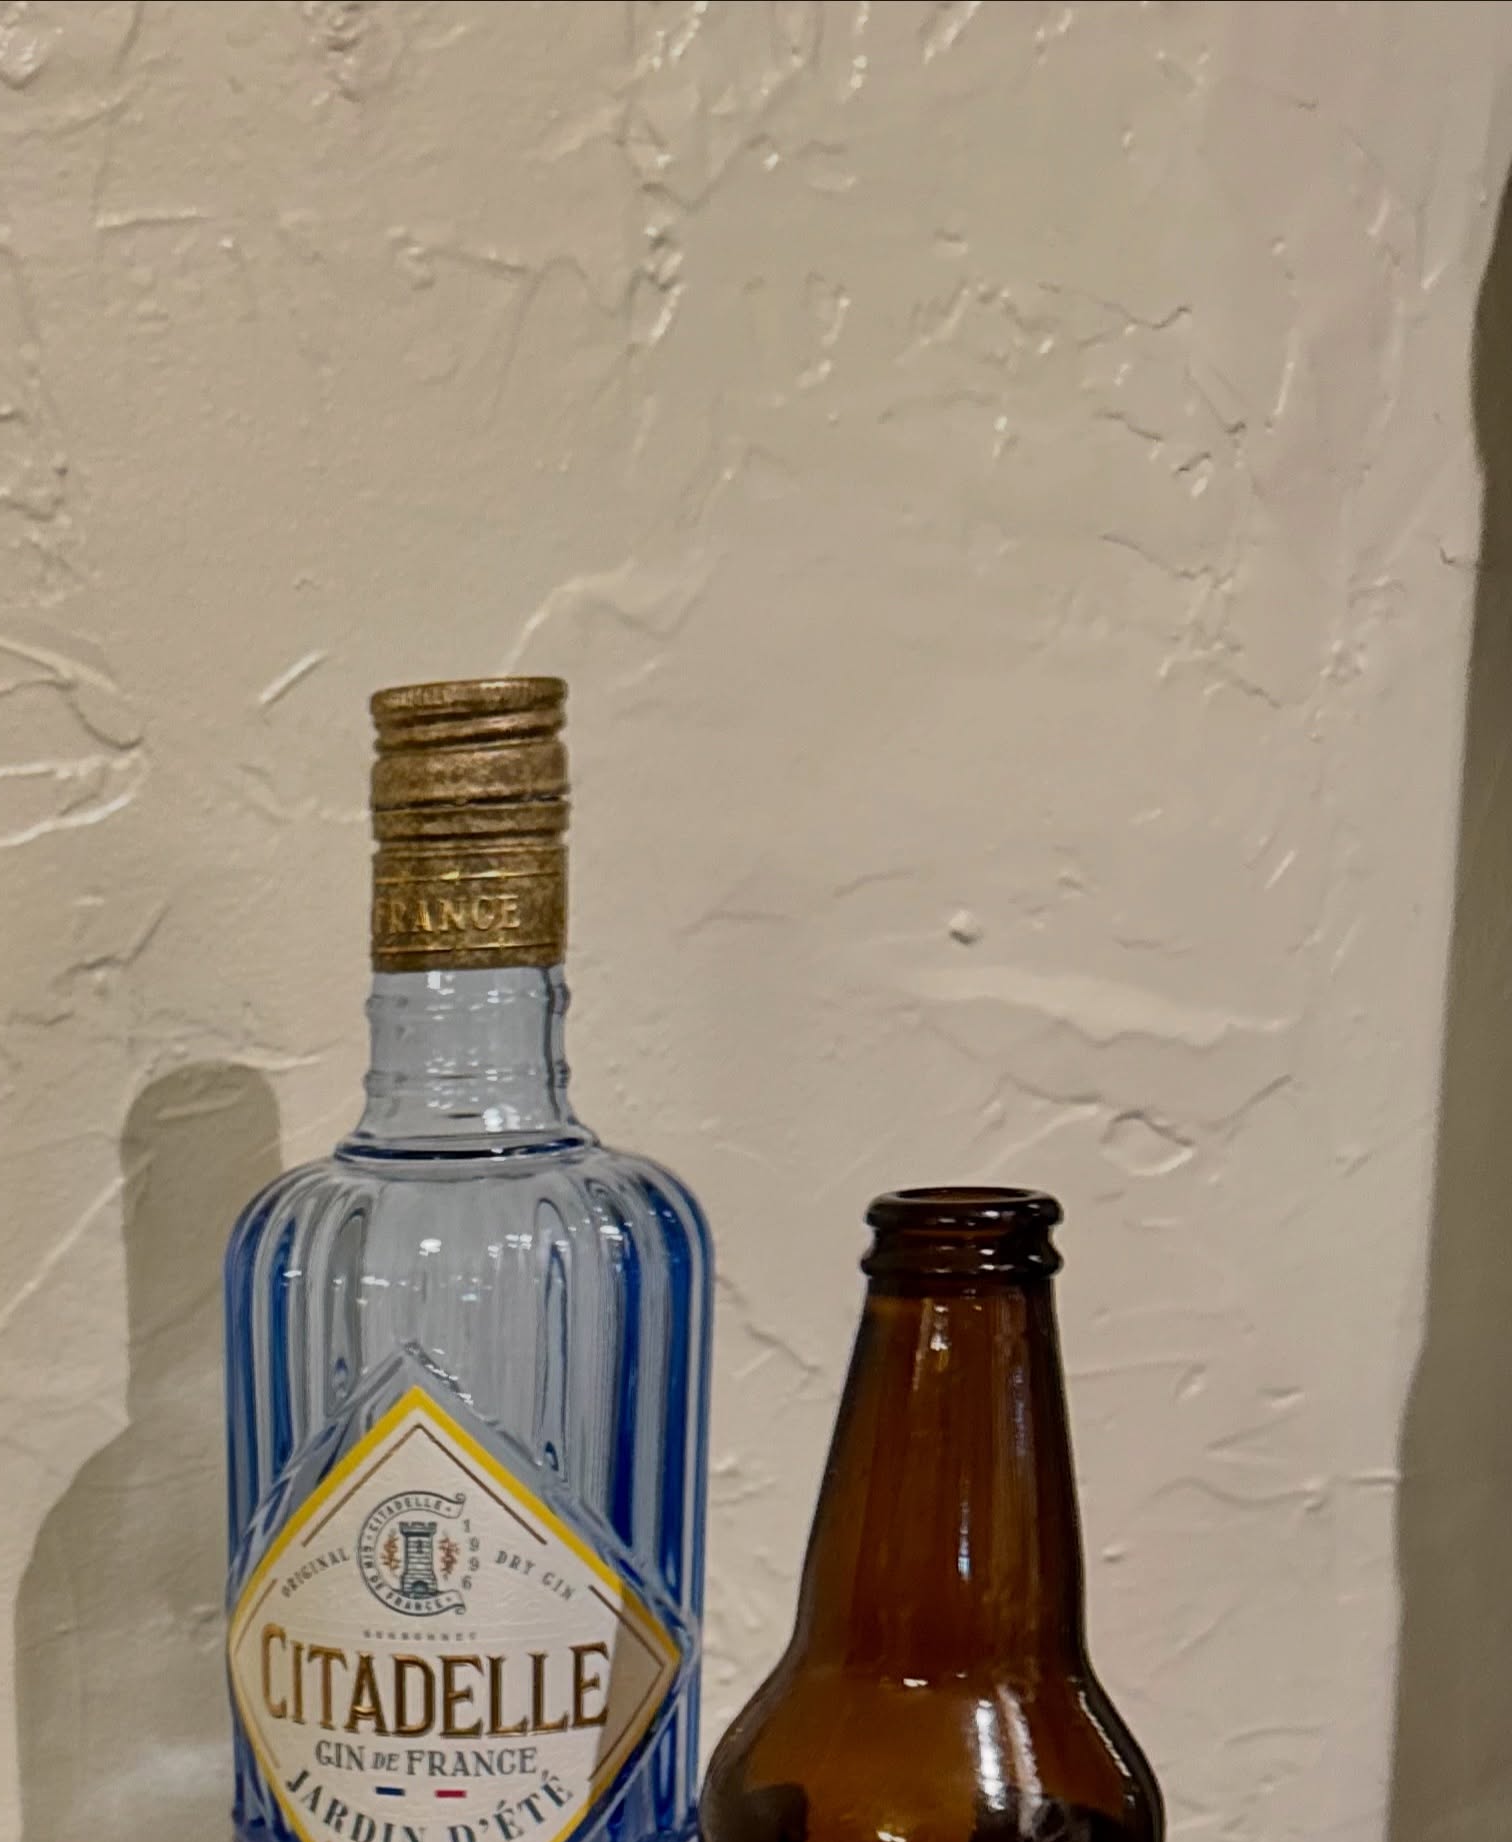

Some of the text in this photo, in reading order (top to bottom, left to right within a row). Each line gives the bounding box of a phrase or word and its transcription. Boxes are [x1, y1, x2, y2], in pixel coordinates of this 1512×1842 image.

[281, 1547, 576, 1600] ORIGINAL DRY GIN
[261, 1622, 608, 1739] CITADELLE
[315, 1739, 365, 1772] GIN
[406, 1747, 538, 1777] FRANCE
